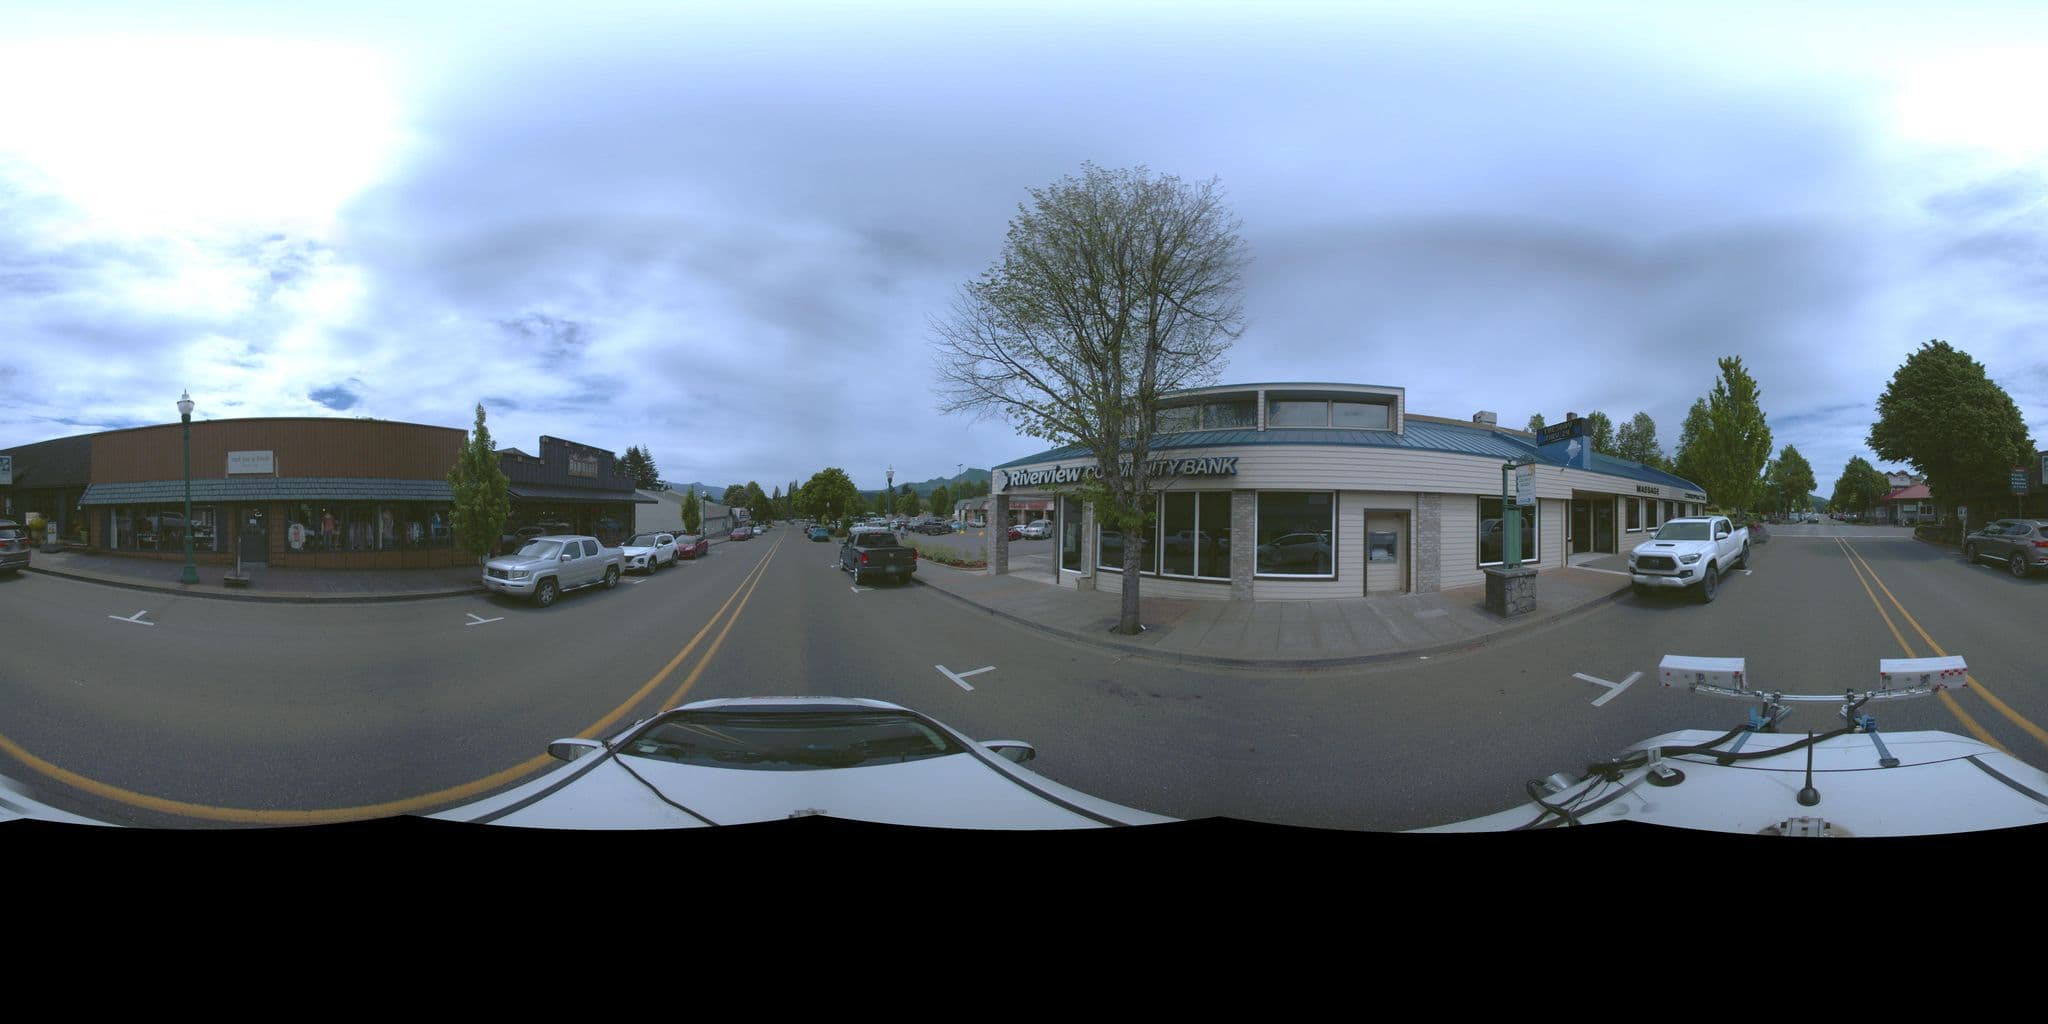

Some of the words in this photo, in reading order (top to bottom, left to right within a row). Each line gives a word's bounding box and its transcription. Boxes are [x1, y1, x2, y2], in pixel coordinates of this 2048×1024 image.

[1010, 467, 1081, 487] Riverview
[1183, 457, 1234, 476] BANK
[1636, 484, 1660, 496] MASSAGE
